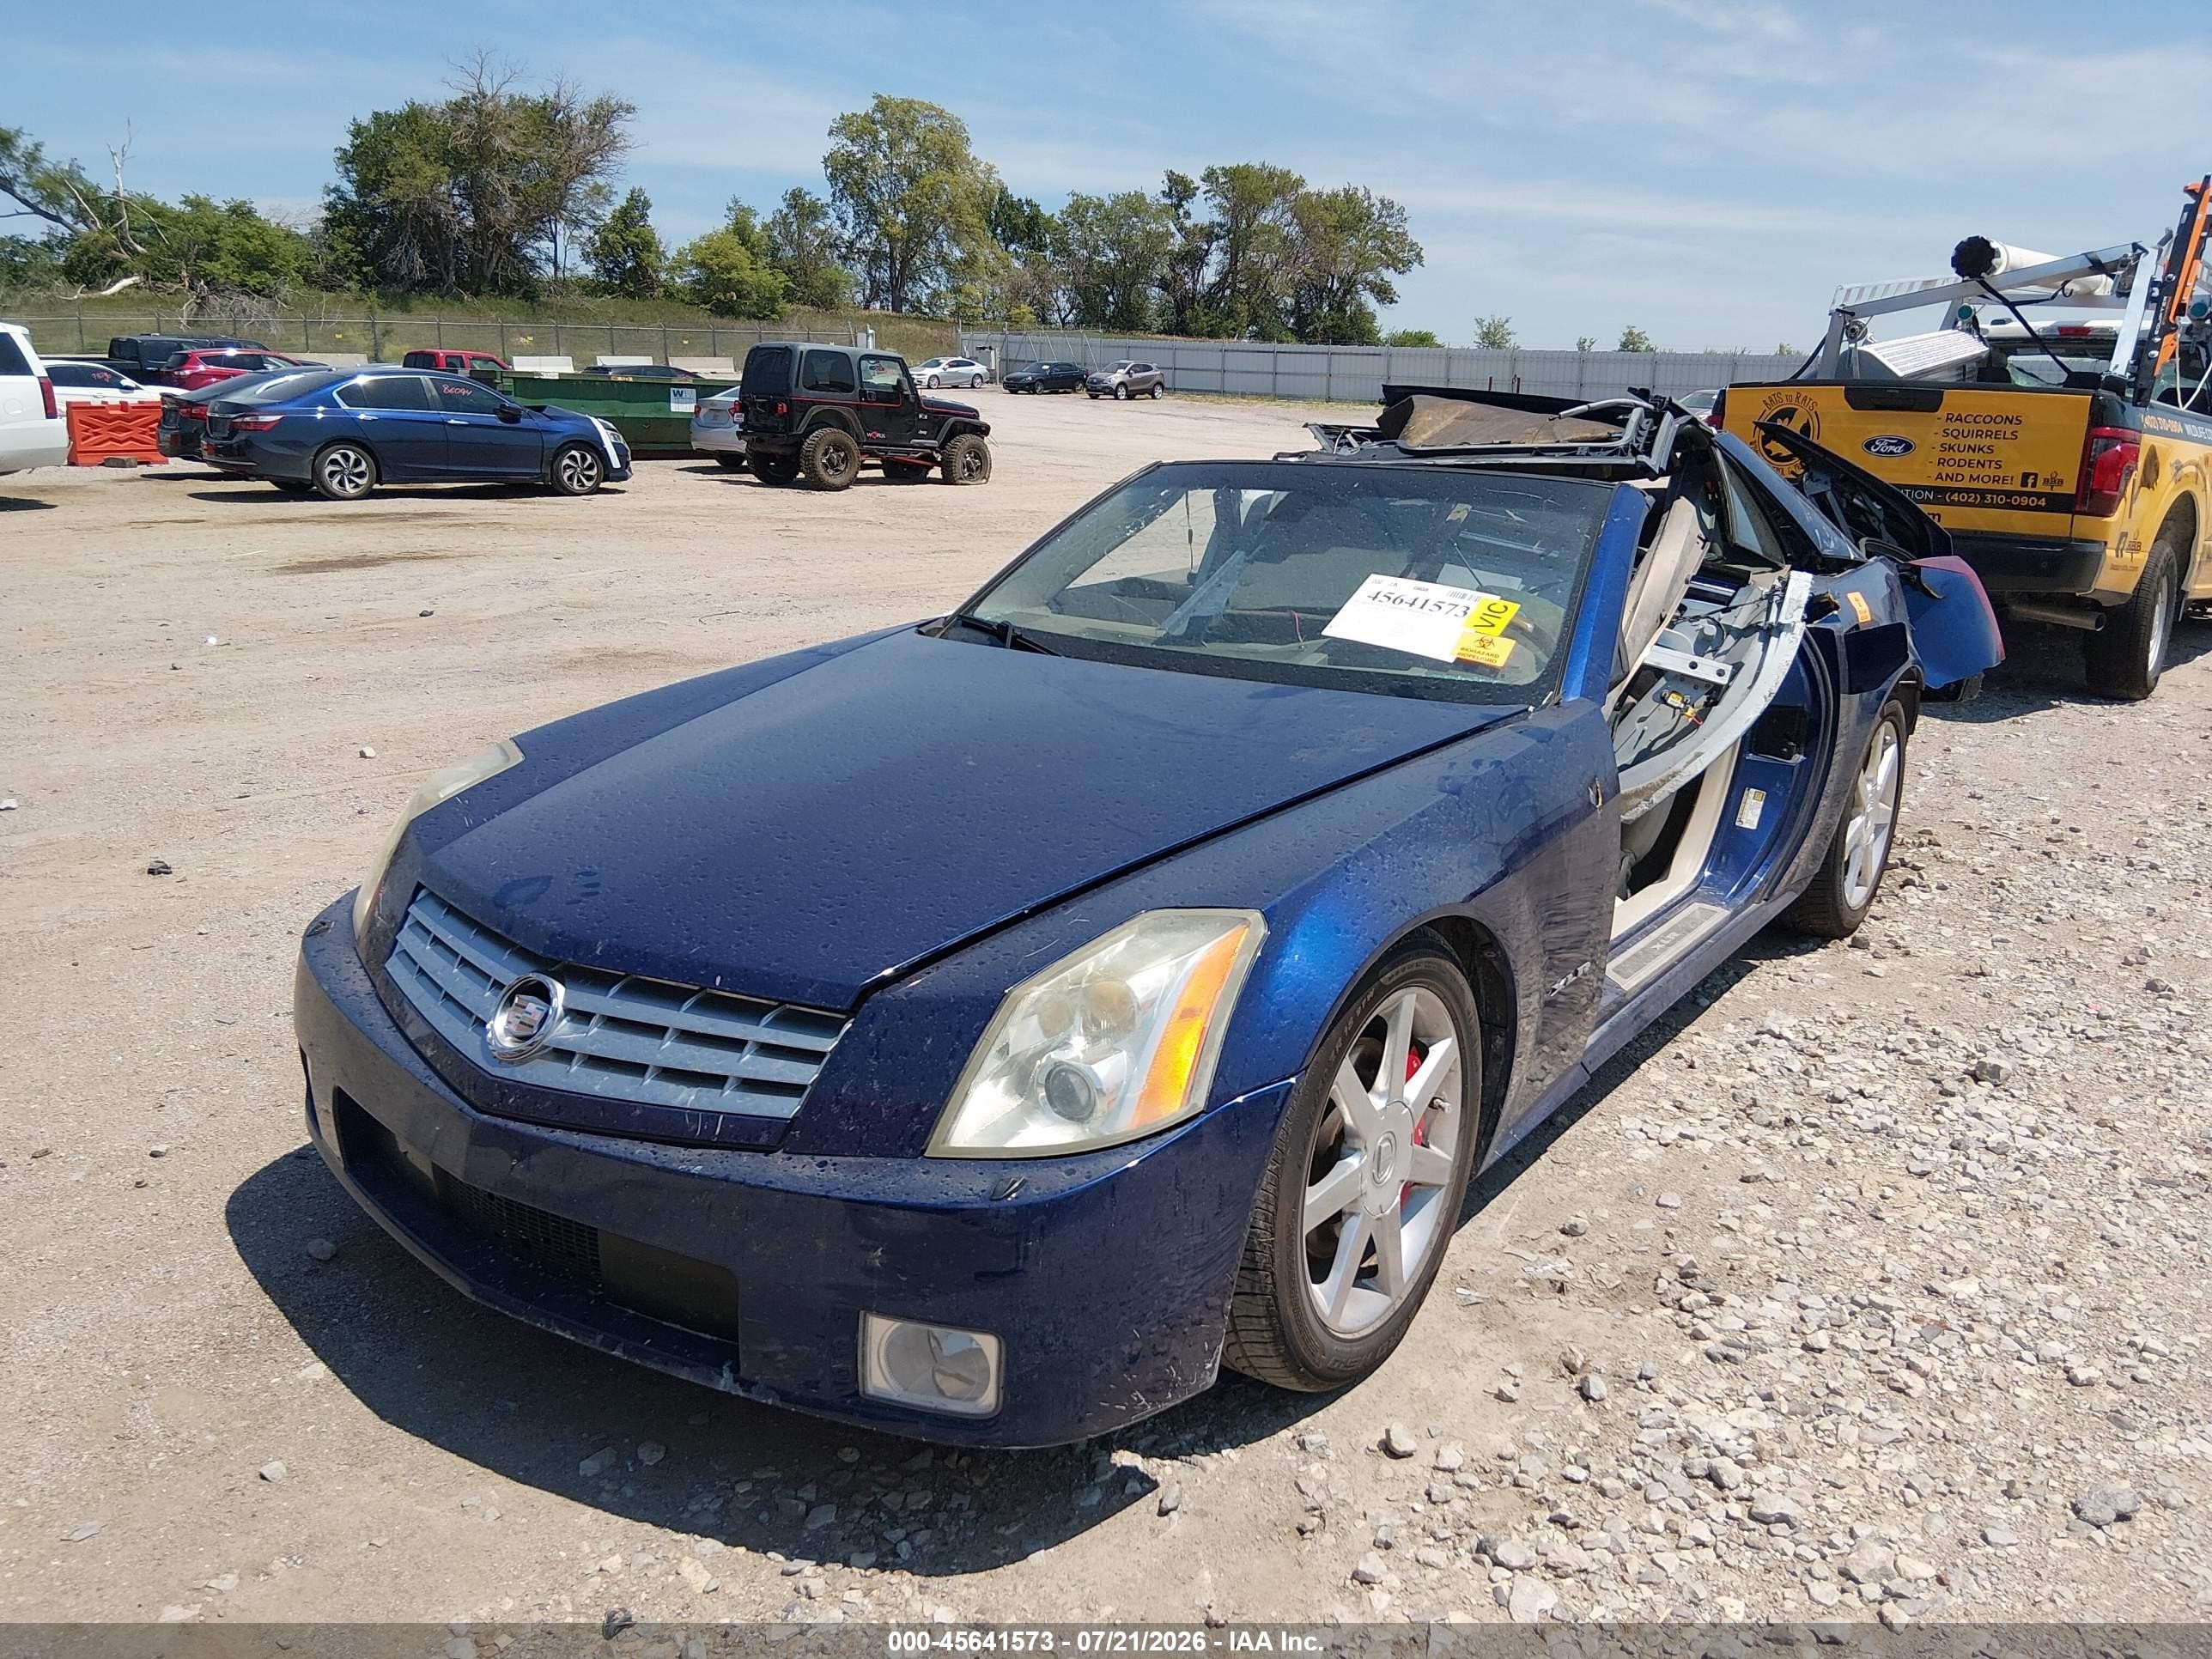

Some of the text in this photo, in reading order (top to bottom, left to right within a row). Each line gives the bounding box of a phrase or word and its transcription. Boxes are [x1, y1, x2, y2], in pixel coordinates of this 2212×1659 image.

[1763, 392, 1784, 410] BATS
[1795, 392, 1818, 411] RATS
[1945, 413, 2023, 425] RACCOONS
[1942, 428, 2019, 441] SQUIRRELS
[1870, 438, 1905, 454] Ford
[1939, 442, 1995, 454] SKUNKS
[1936, 457, 2002, 470] RODENTS
[1935, 471, 1965, 483] AND
[1968, 473, 2014, 485] MORE!
[1945, 493, 1981, 504] (402)
[1984, 495, 2046, 507] 310-0904
[1367, 590, 1470, 617] 45641573
